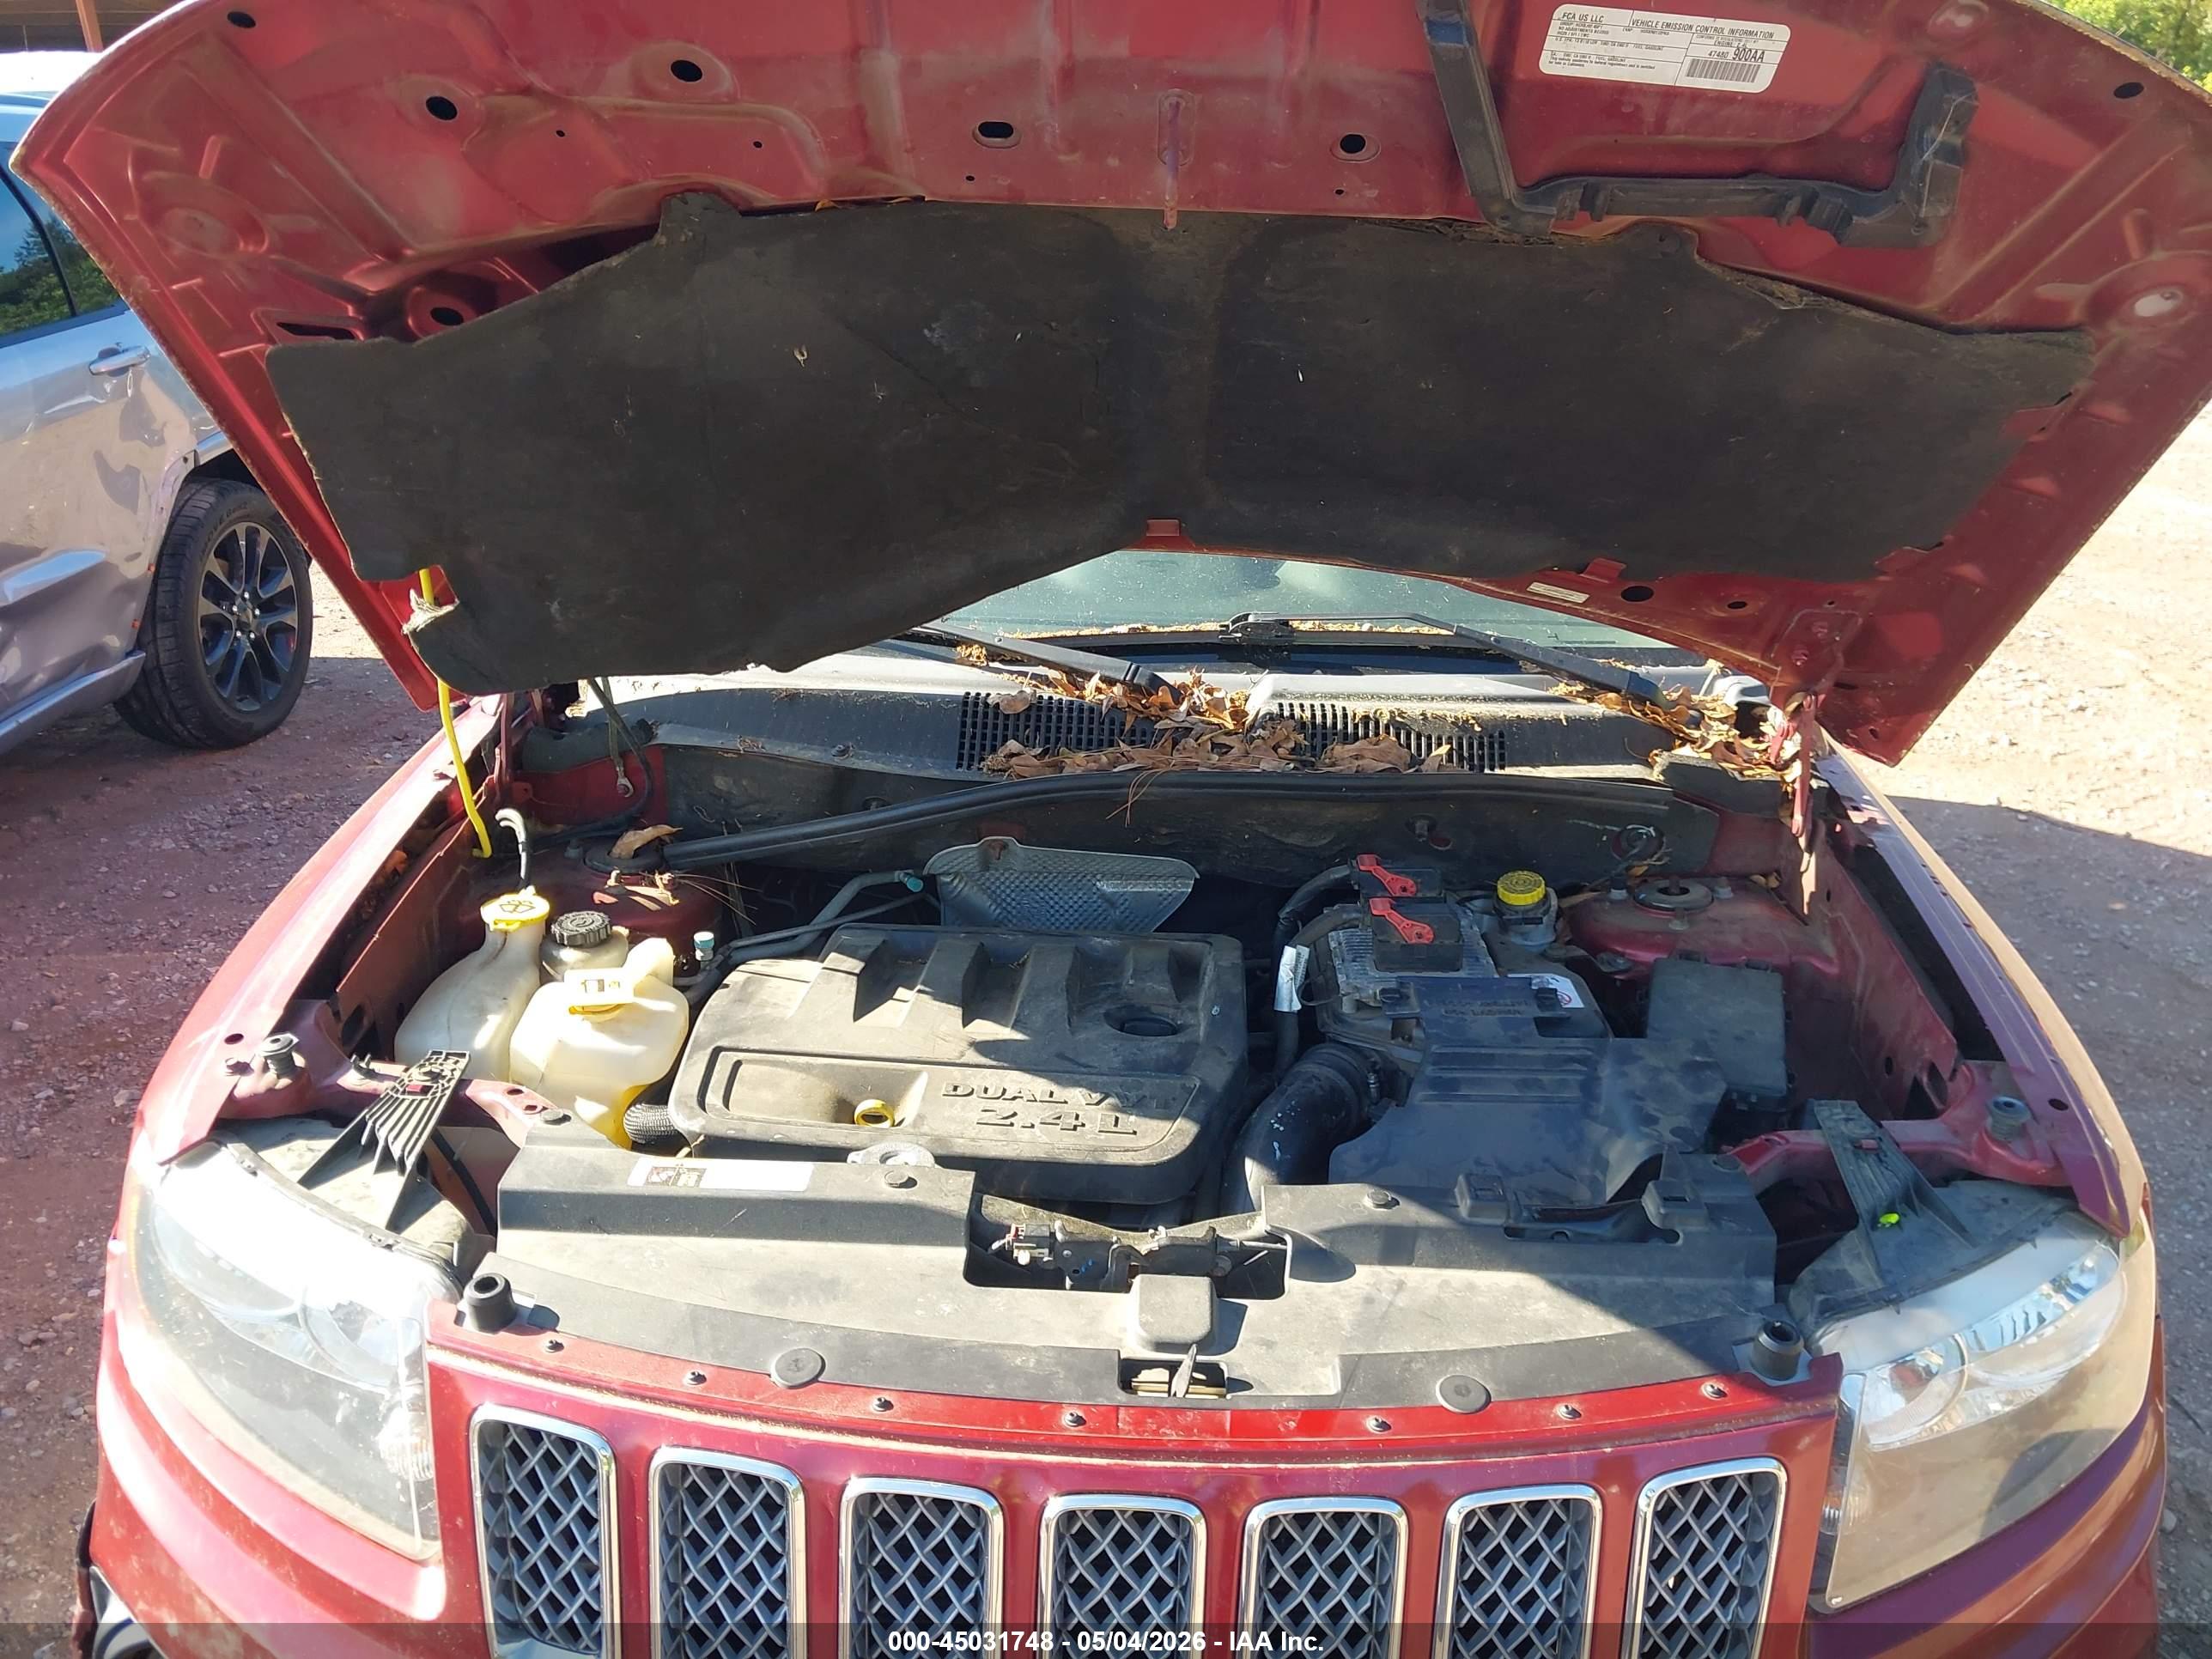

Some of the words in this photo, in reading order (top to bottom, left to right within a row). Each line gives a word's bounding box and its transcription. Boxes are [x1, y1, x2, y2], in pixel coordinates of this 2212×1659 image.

[1562, 12, 1576, 21] FCA
[1590, 15, 1604, 23] LLC
[1632, 19, 1660, 28] VEHICLE
[1661, 22, 1693, 32] EMISSION
[1695, 25, 1725, 35] CONTROL
[1728, 27, 1775, 40] INFORMATION
[1732, 47, 1765, 63] 900AA
[942, 1082, 1068, 1104] DUAL
